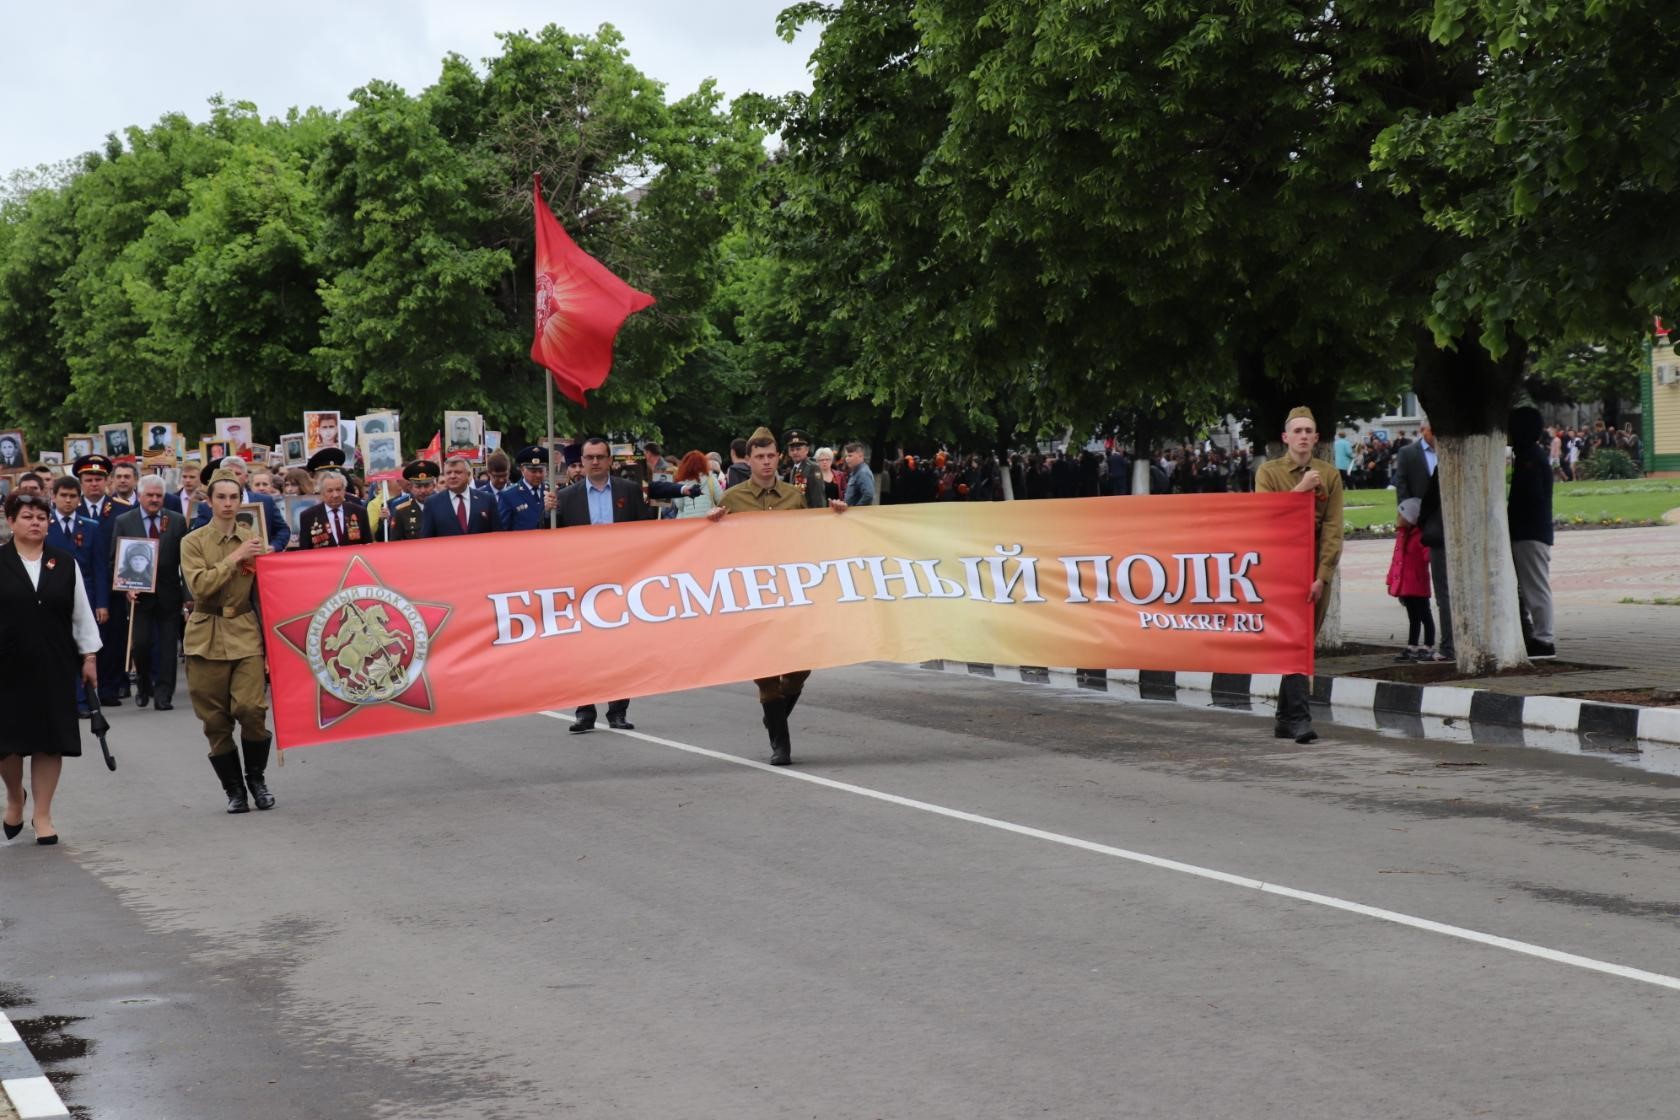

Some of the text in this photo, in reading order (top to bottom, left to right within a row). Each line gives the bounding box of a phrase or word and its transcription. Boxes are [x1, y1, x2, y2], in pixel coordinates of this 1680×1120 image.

[309, 586, 427, 674] БЕССМЕРТНЫЙ ПОЛК РОССИИ
[487, 543, 1264, 646] БЕССМЕРТНЫЙ ПОЛК
[1137, 611, 1265, 633] POLKRF.RU
